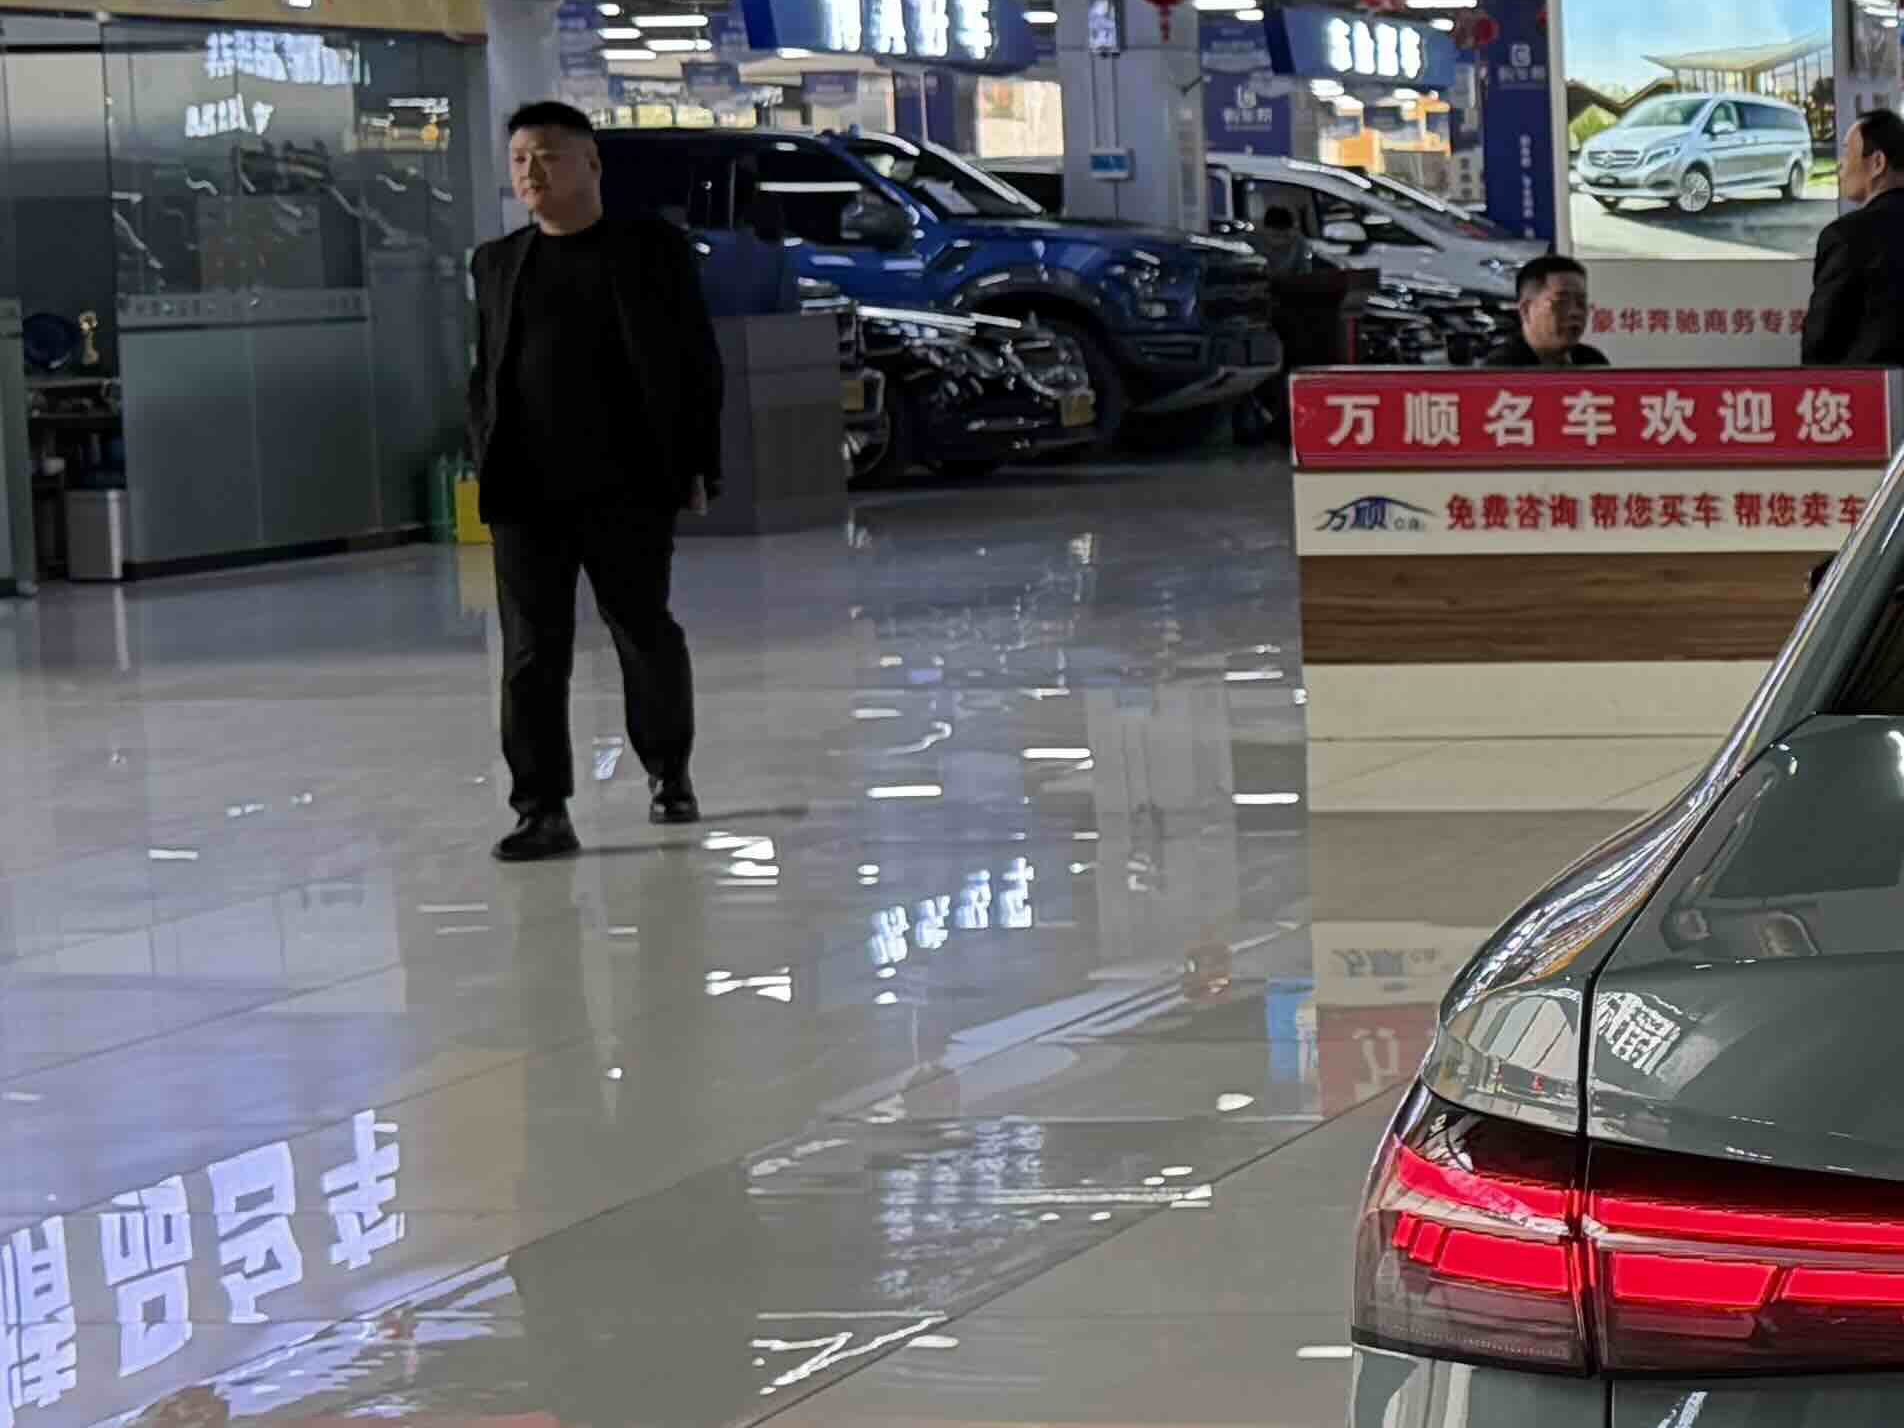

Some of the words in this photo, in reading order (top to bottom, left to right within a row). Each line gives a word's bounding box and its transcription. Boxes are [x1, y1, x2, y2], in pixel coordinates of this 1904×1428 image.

[1325, 390, 1853, 447] 万顺名车欢迎您
[1446, 493, 1579, 531] 免费咨询
[1591, 493, 1721, 530] 帮您买车
[1735, 492, 1865, 529] 帮您卖车
